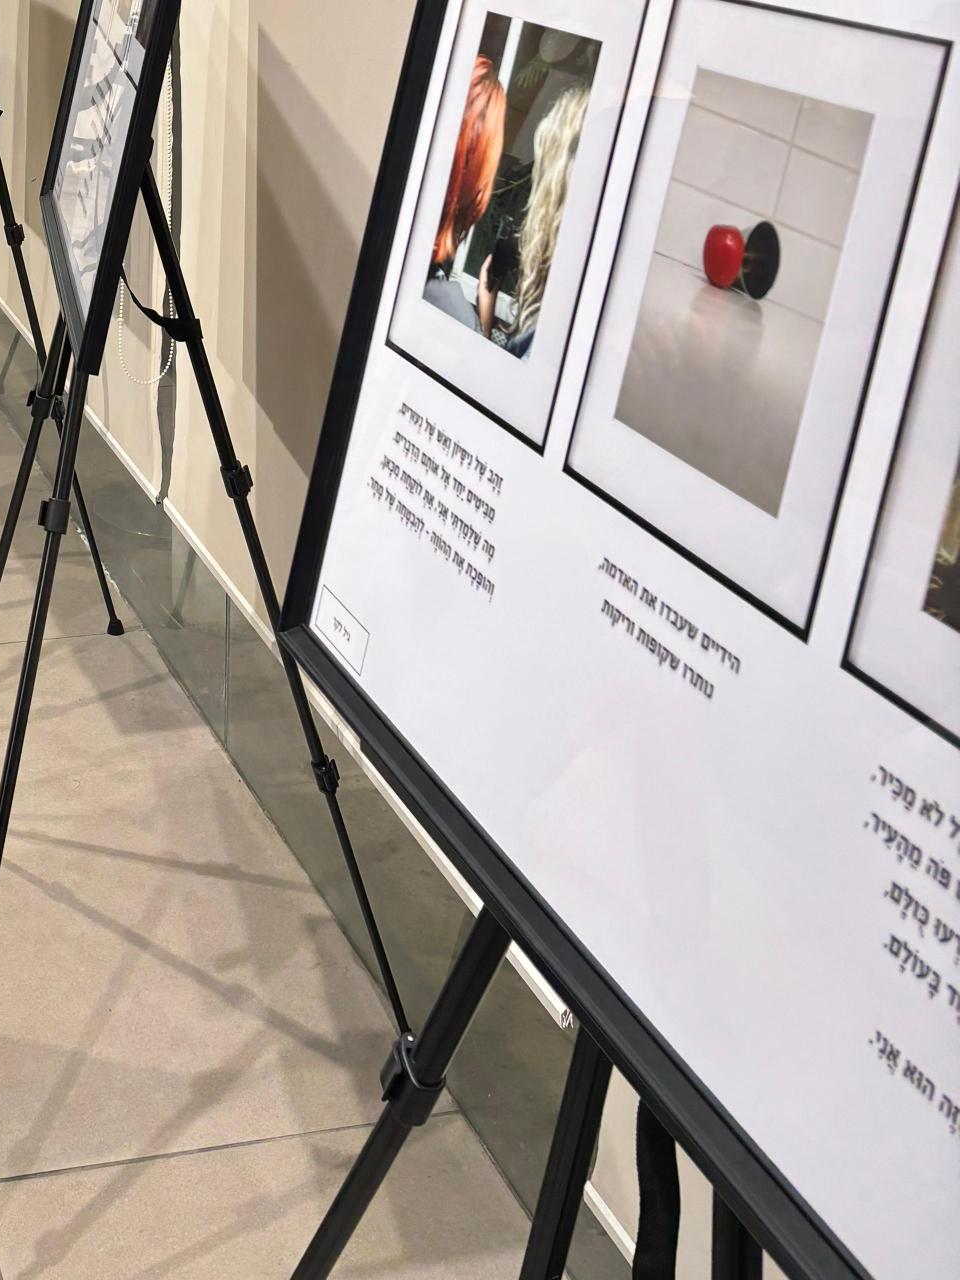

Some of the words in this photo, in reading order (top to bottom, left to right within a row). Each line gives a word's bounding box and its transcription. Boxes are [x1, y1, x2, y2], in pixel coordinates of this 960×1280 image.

[601, 598, 636, 636] וריקות
[639, 586, 658, 610] את
[658, 600, 699, 640] שעבדו
[636, 627, 681, 670] שקופות
[700, 631, 741, 674] הידיים
[682, 662, 715, 699] נותרו
